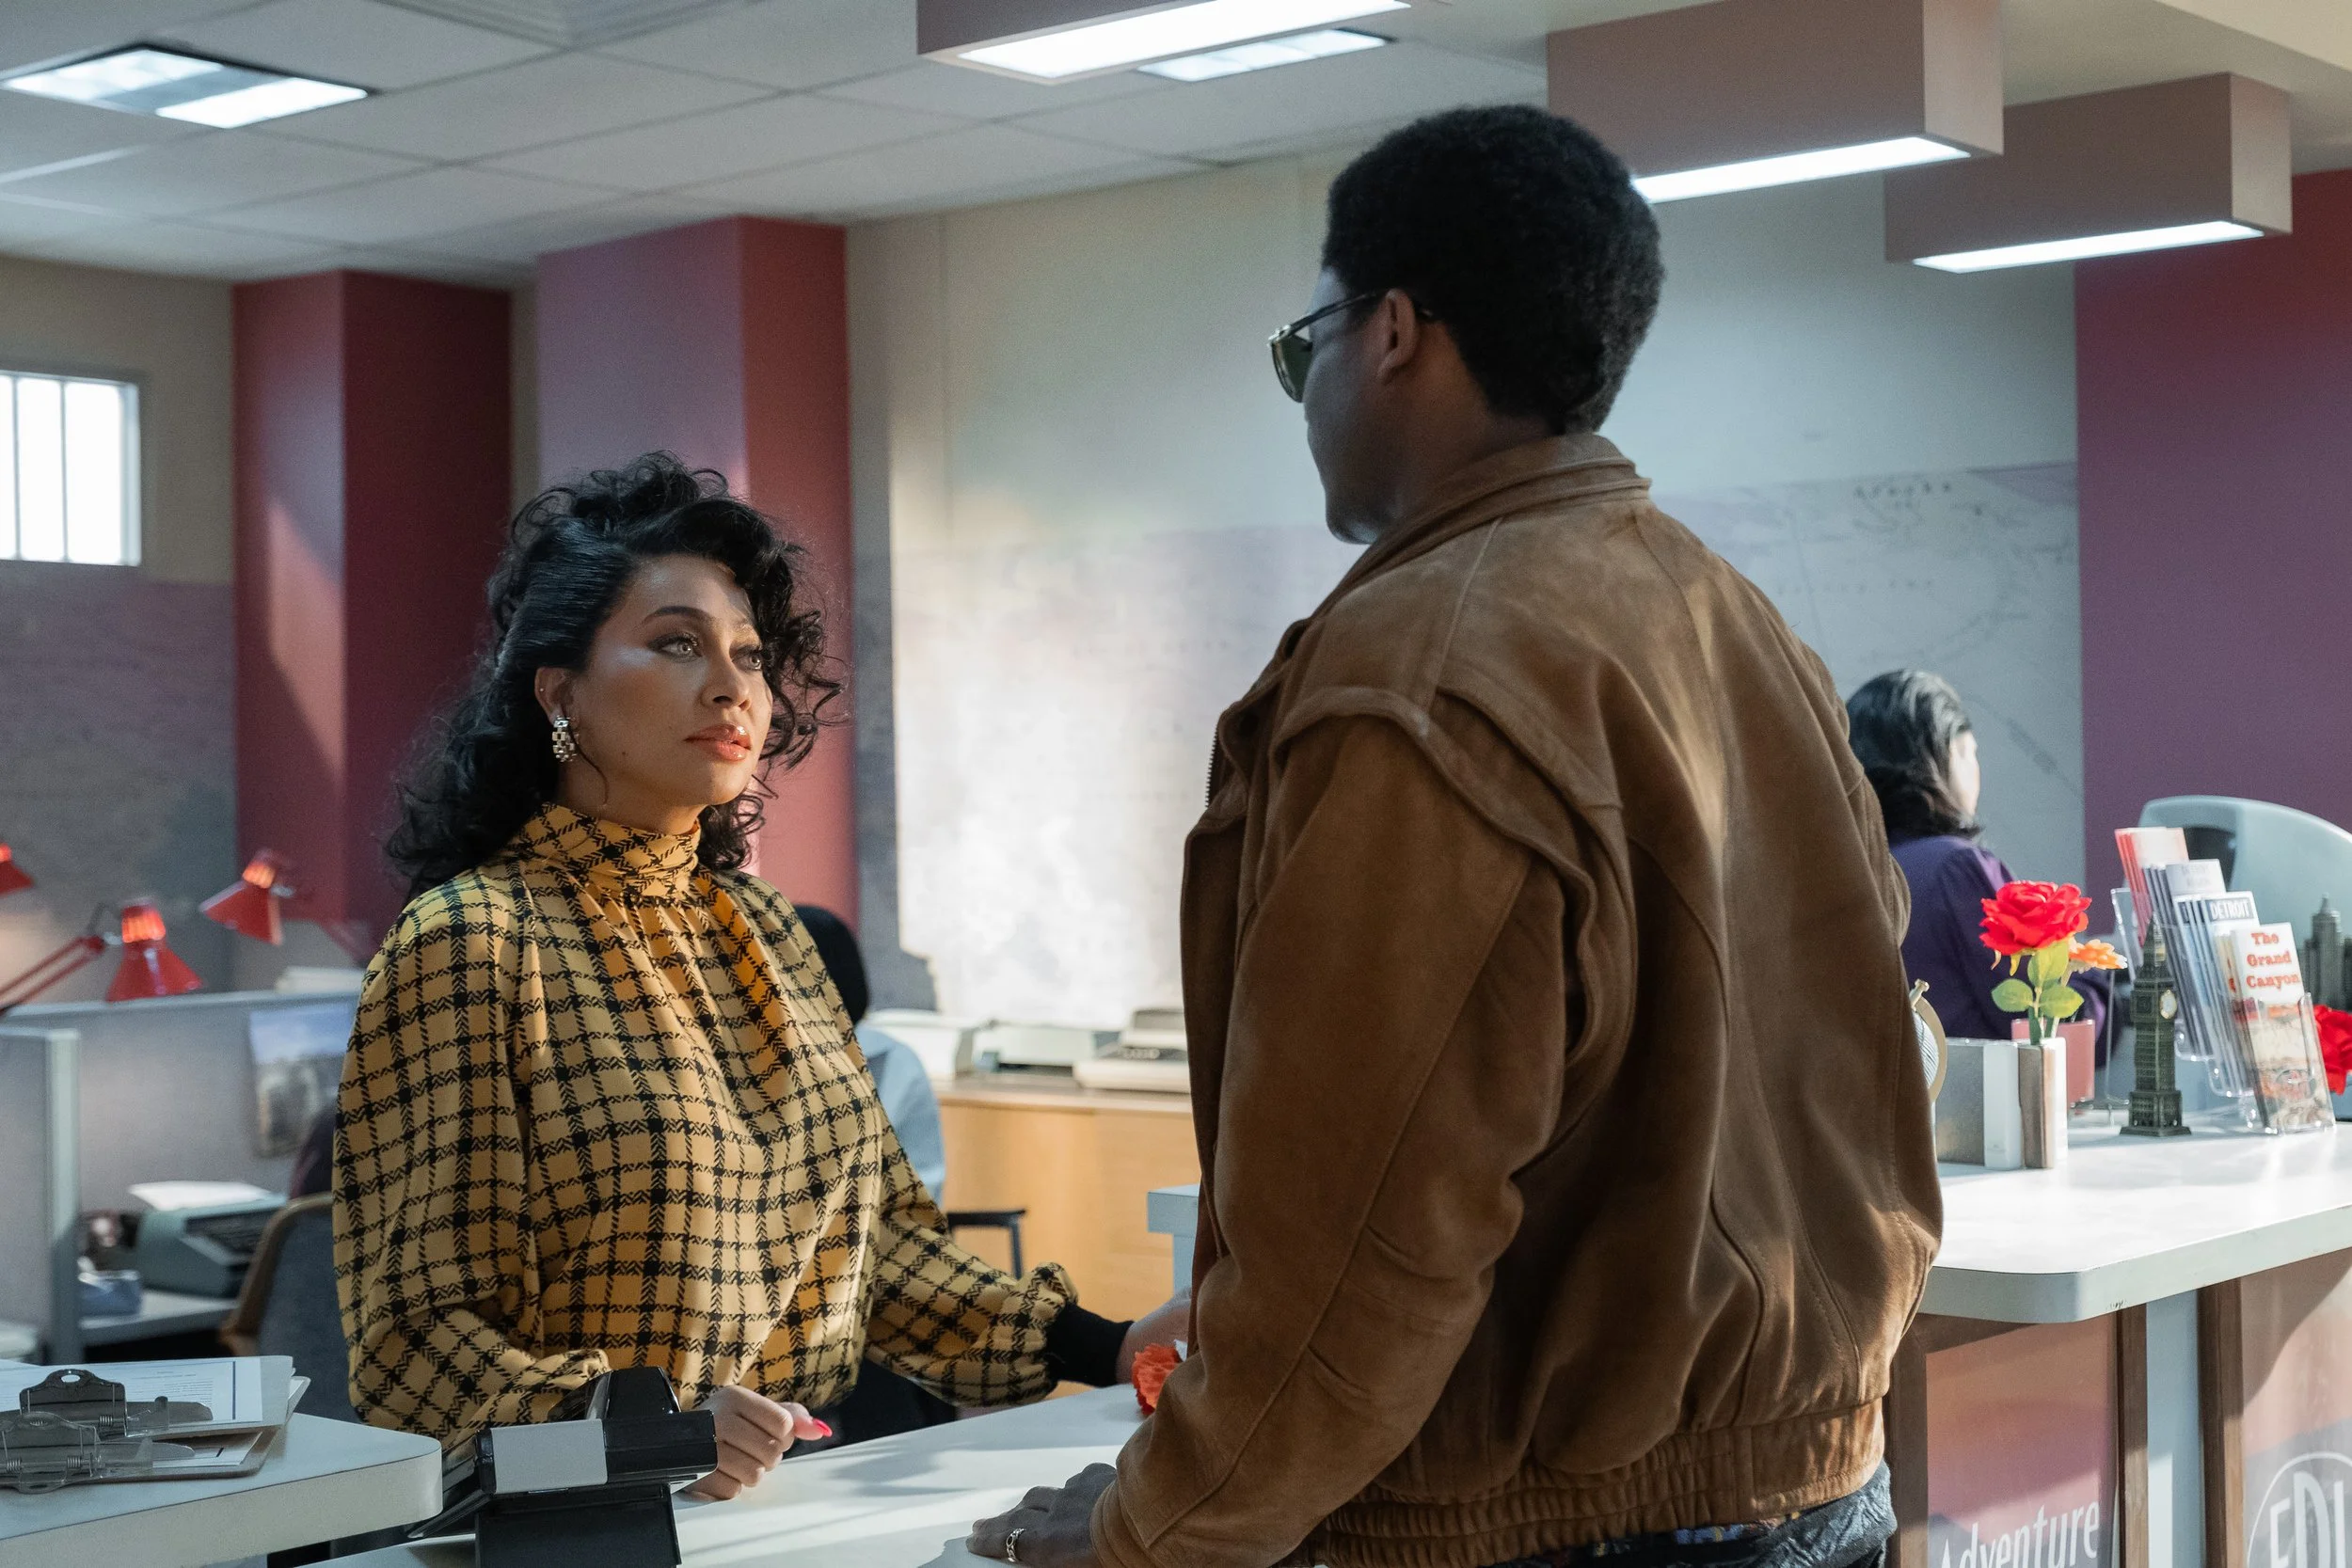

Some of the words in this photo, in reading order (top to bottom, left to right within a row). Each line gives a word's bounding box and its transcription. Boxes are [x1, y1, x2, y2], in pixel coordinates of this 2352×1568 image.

[2210, 898, 2250, 921] DETROIT
[2250, 932, 2280, 945] The
[2246, 951, 2293, 967] Grand
[2246, 974, 2301, 990] Canyon
